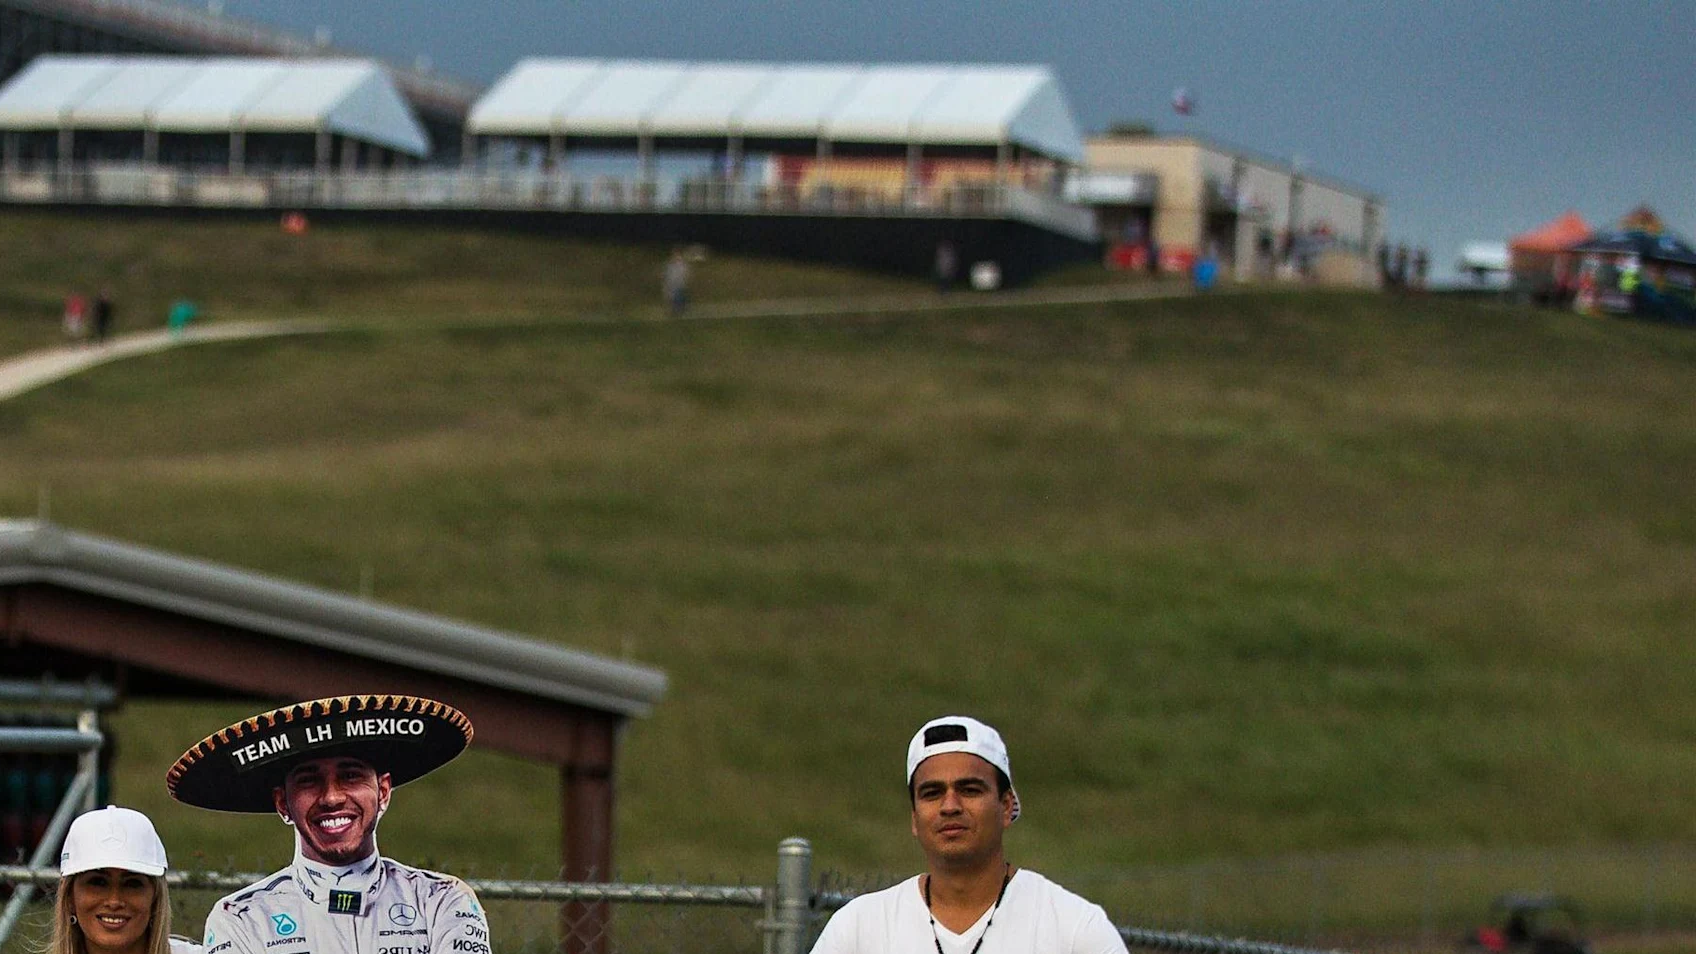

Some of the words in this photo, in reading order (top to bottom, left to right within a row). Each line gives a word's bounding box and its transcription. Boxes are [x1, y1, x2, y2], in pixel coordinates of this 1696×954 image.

[232, 733, 291, 766] TEAM
[305, 723, 333, 744] LH
[346, 718, 424, 737] MEXICO
